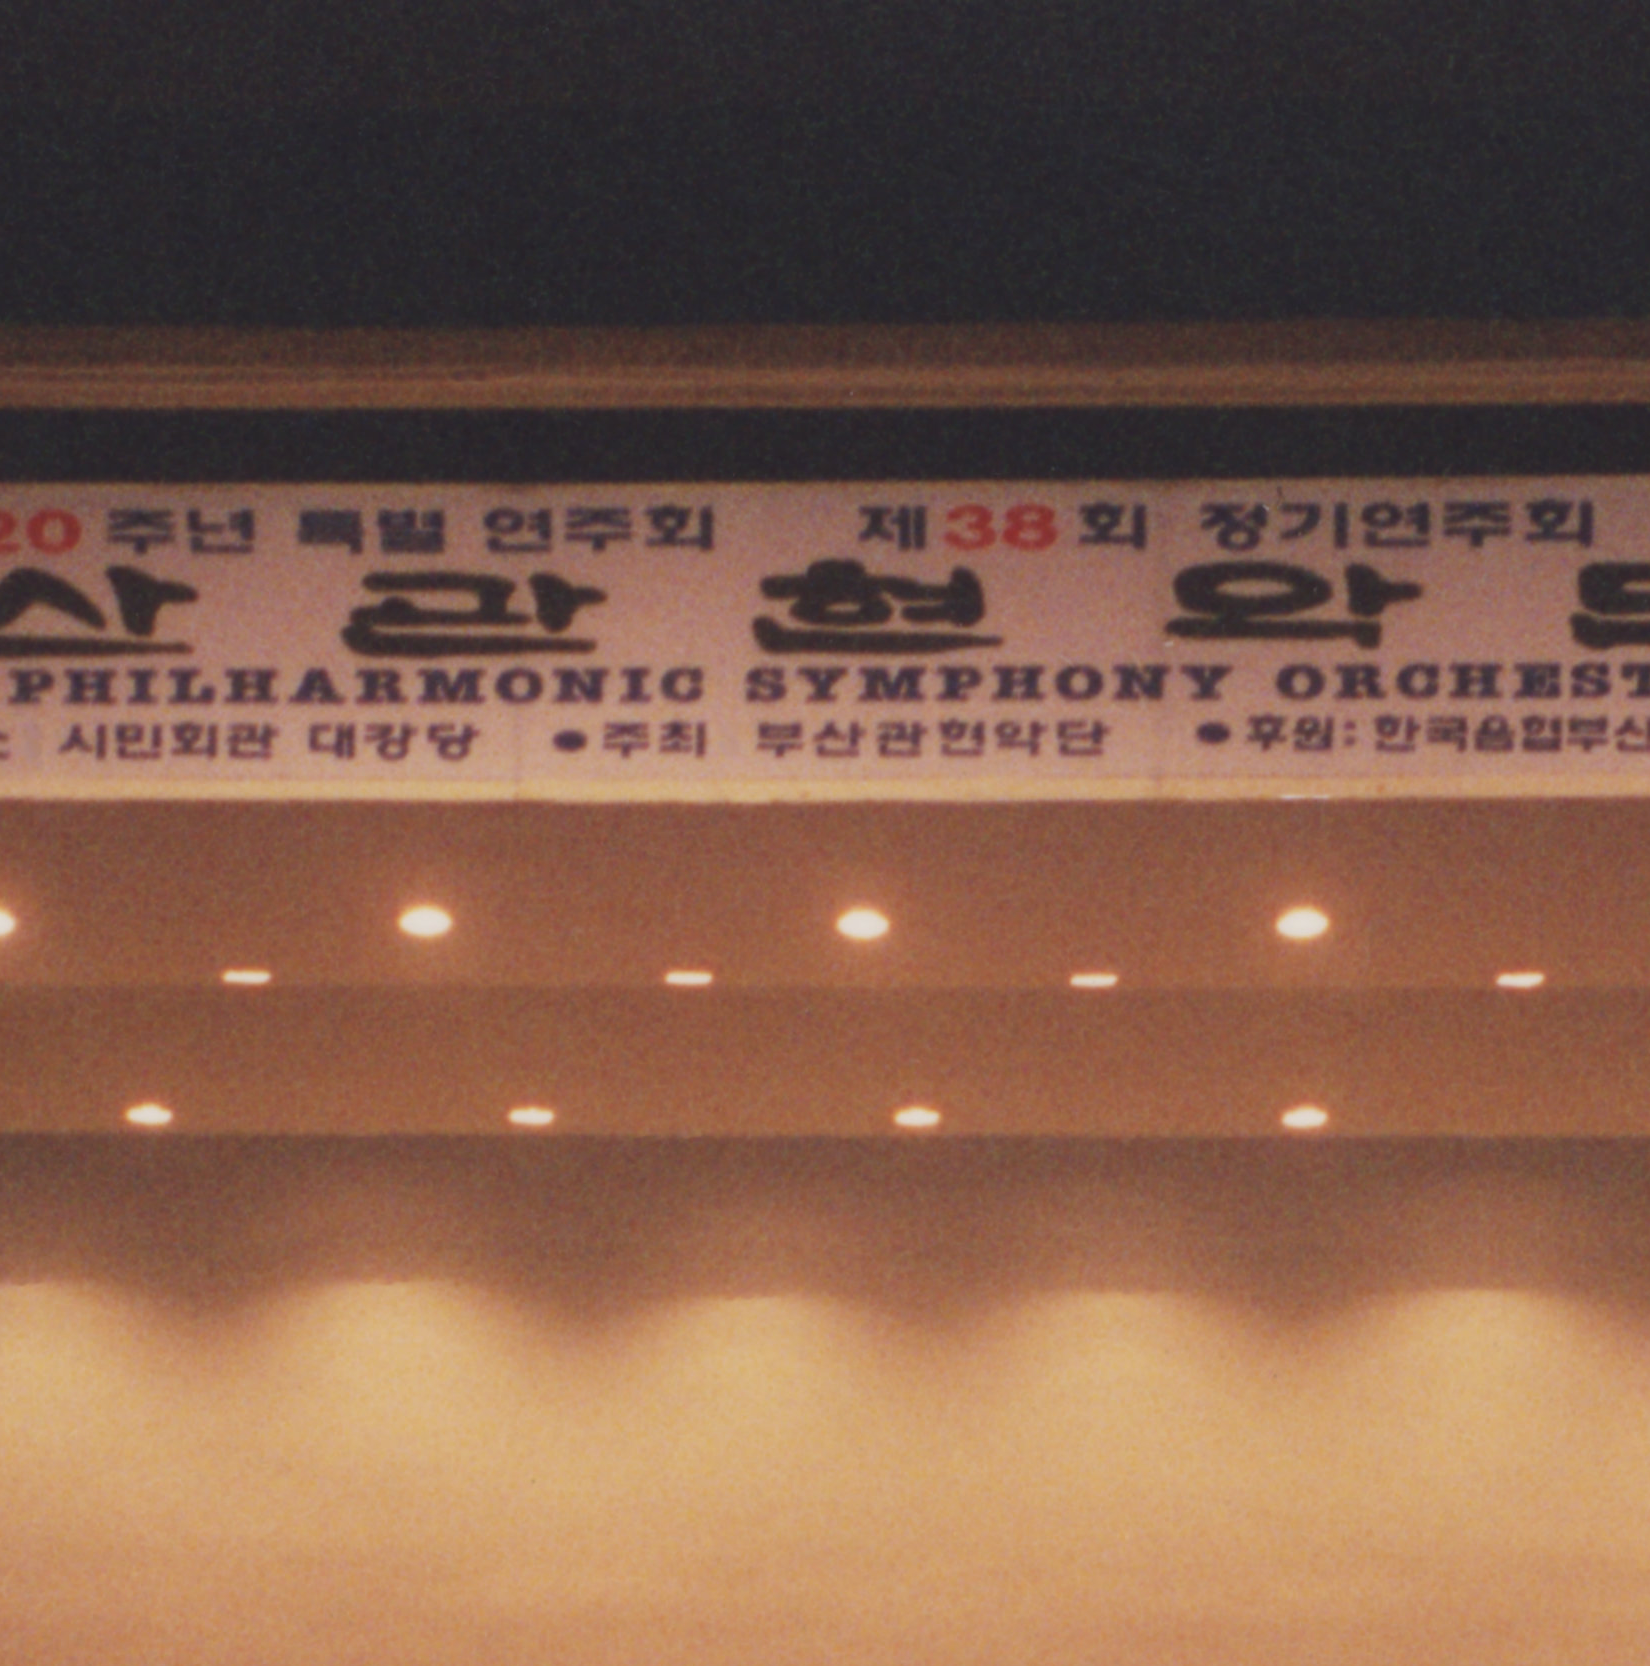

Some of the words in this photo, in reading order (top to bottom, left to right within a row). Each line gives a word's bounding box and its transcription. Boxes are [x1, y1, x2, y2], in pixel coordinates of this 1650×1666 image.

[1200, 500, 1594, 551] 정기연주회
[8, 666, 704, 706] PHILHARMONIC
[745, 662, 1233, 704] SYMPHONY
[60, 721, 278, 760] 시민회관
[604, 719, 707, 758] 주최
[757, 718, 1110, 758] 부산관현악단
